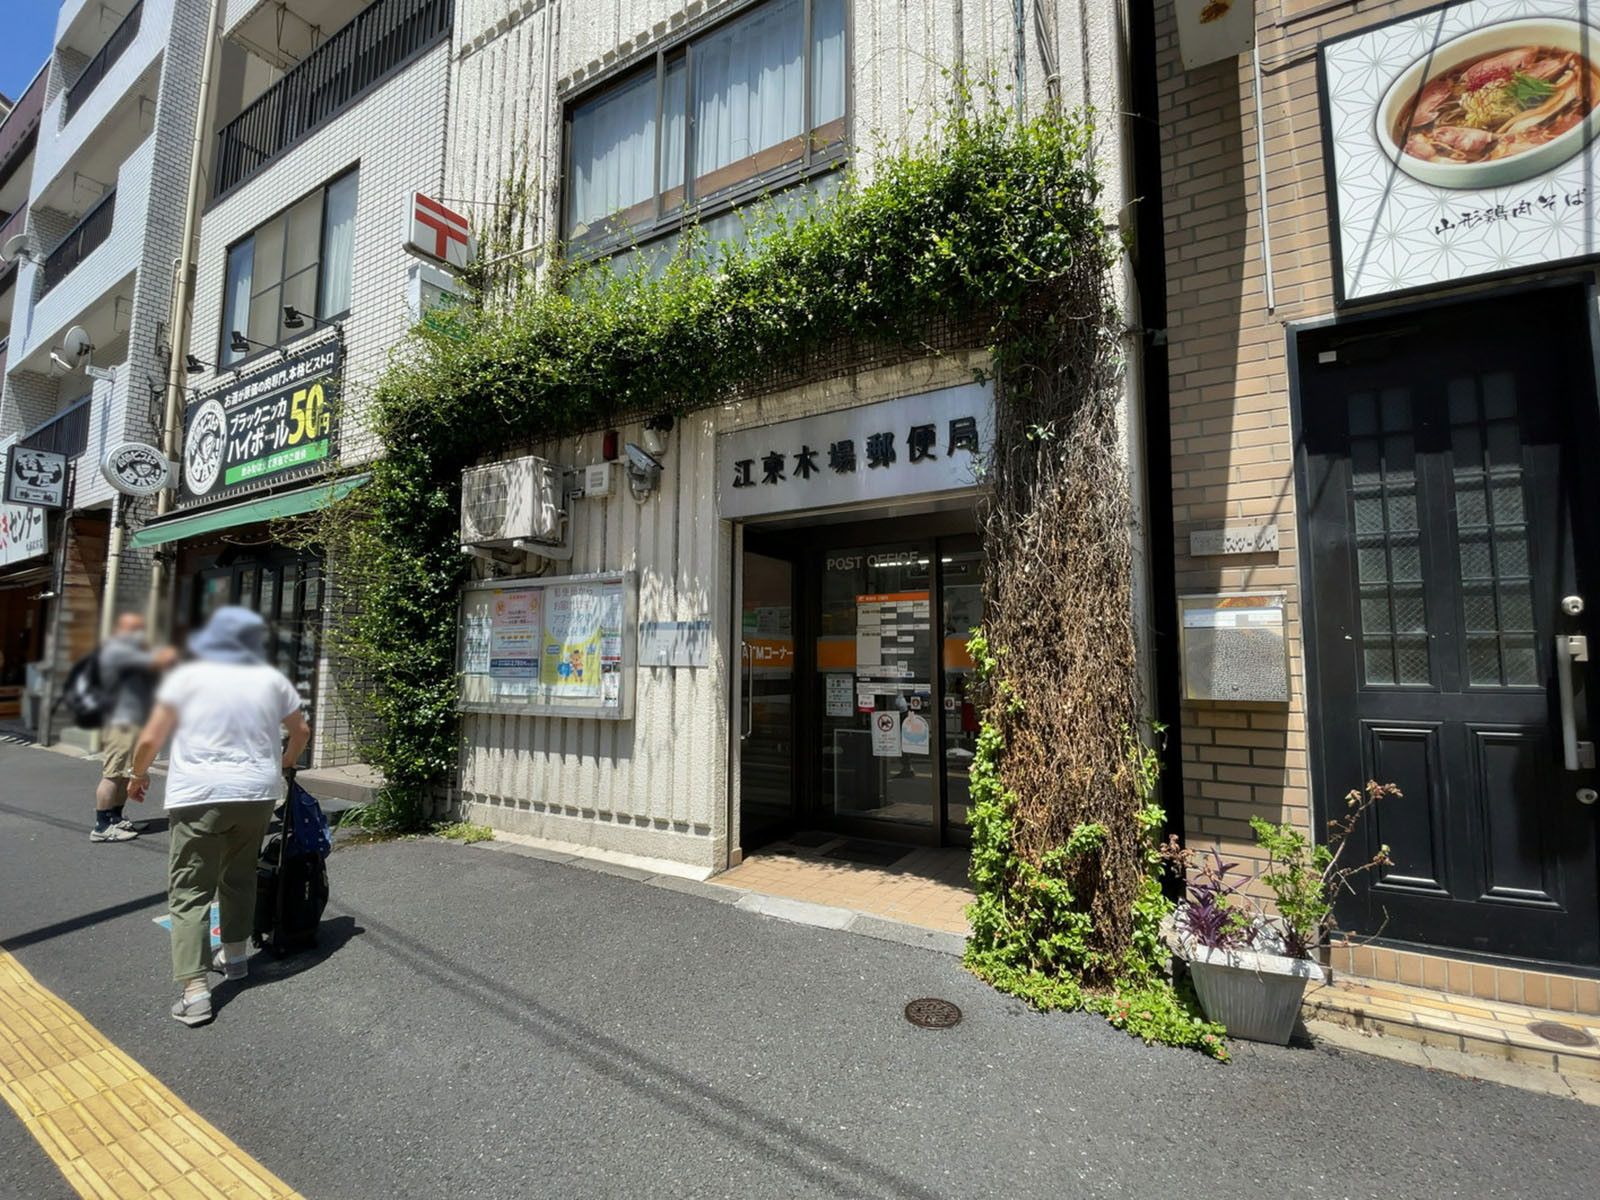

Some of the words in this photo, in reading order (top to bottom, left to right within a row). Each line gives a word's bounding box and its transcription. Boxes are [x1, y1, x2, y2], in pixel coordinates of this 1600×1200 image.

[230, 397, 287, 435] ブラックニッカ
[227, 419, 290, 462] ハイボール
[732, 415, 979, 488] 江東木場郵便局
[826, 556, 862, 571] POST
[867, 551, 919, 568] OFFICE
